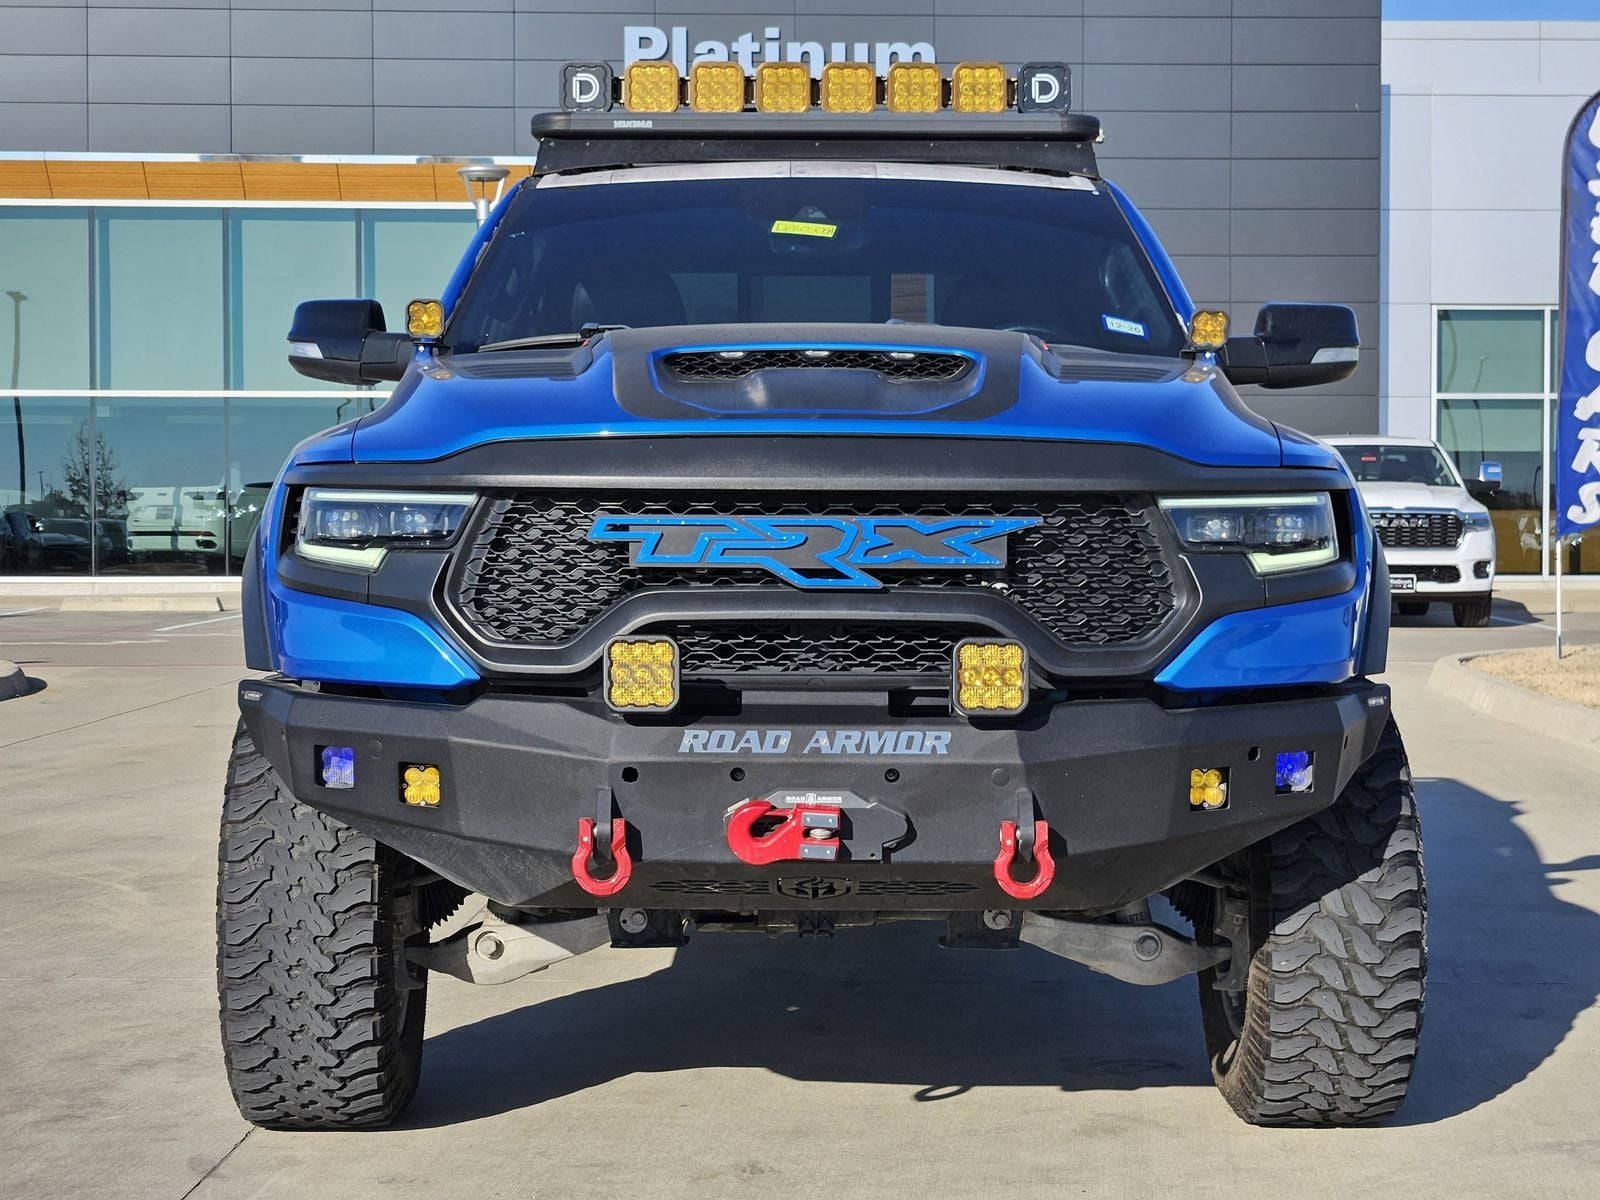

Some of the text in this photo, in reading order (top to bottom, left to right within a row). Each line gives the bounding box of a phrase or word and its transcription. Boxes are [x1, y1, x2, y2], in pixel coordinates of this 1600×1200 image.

[573, 73, 600, 102] D
[1032, 73, 1060, 103] D
[613, 120, 653, 128] YAKIMA
[587, 515, 1043, 589] TRX
[678, 730, 951, 755] ROAD ARMOR
